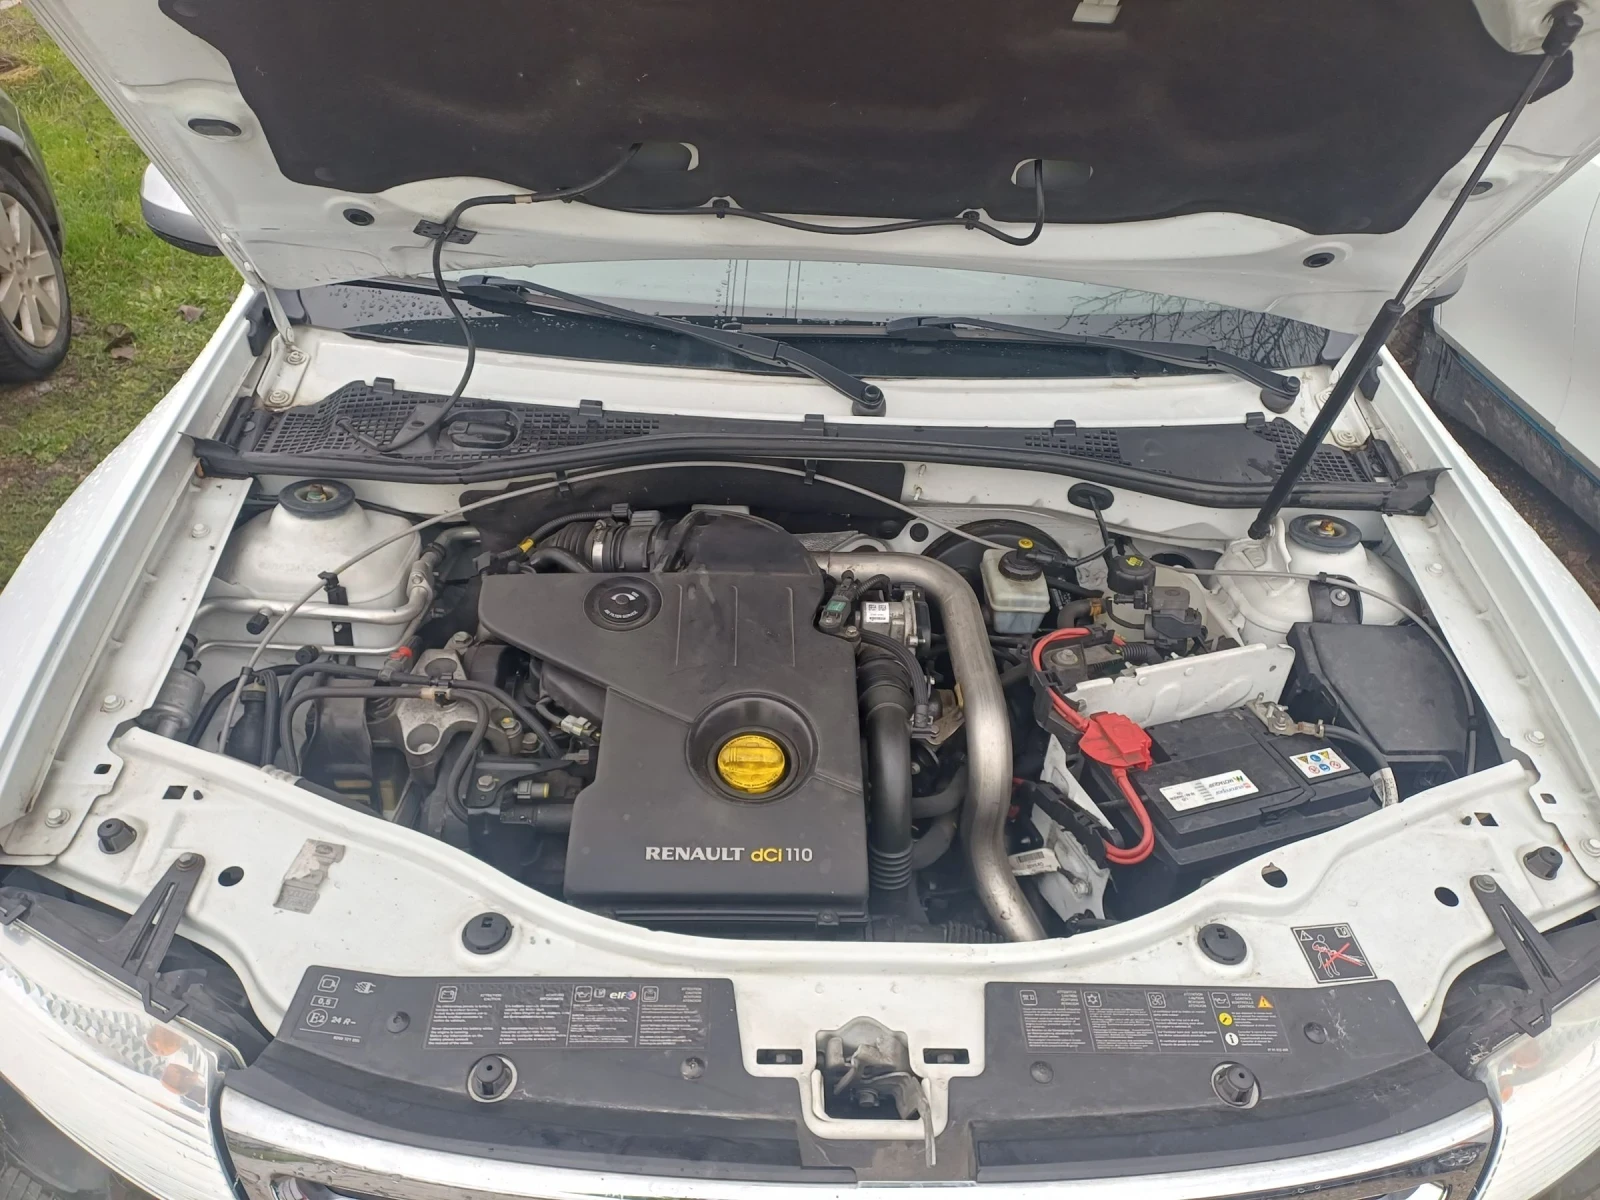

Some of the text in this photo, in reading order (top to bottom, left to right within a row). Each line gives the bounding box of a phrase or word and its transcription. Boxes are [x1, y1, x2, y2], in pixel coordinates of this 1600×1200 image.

[645, 846, 813, 862] RENAULT dCi 110
[609, 991, 626, 1000] elf
[331, 1016, 342, 1024] 24
